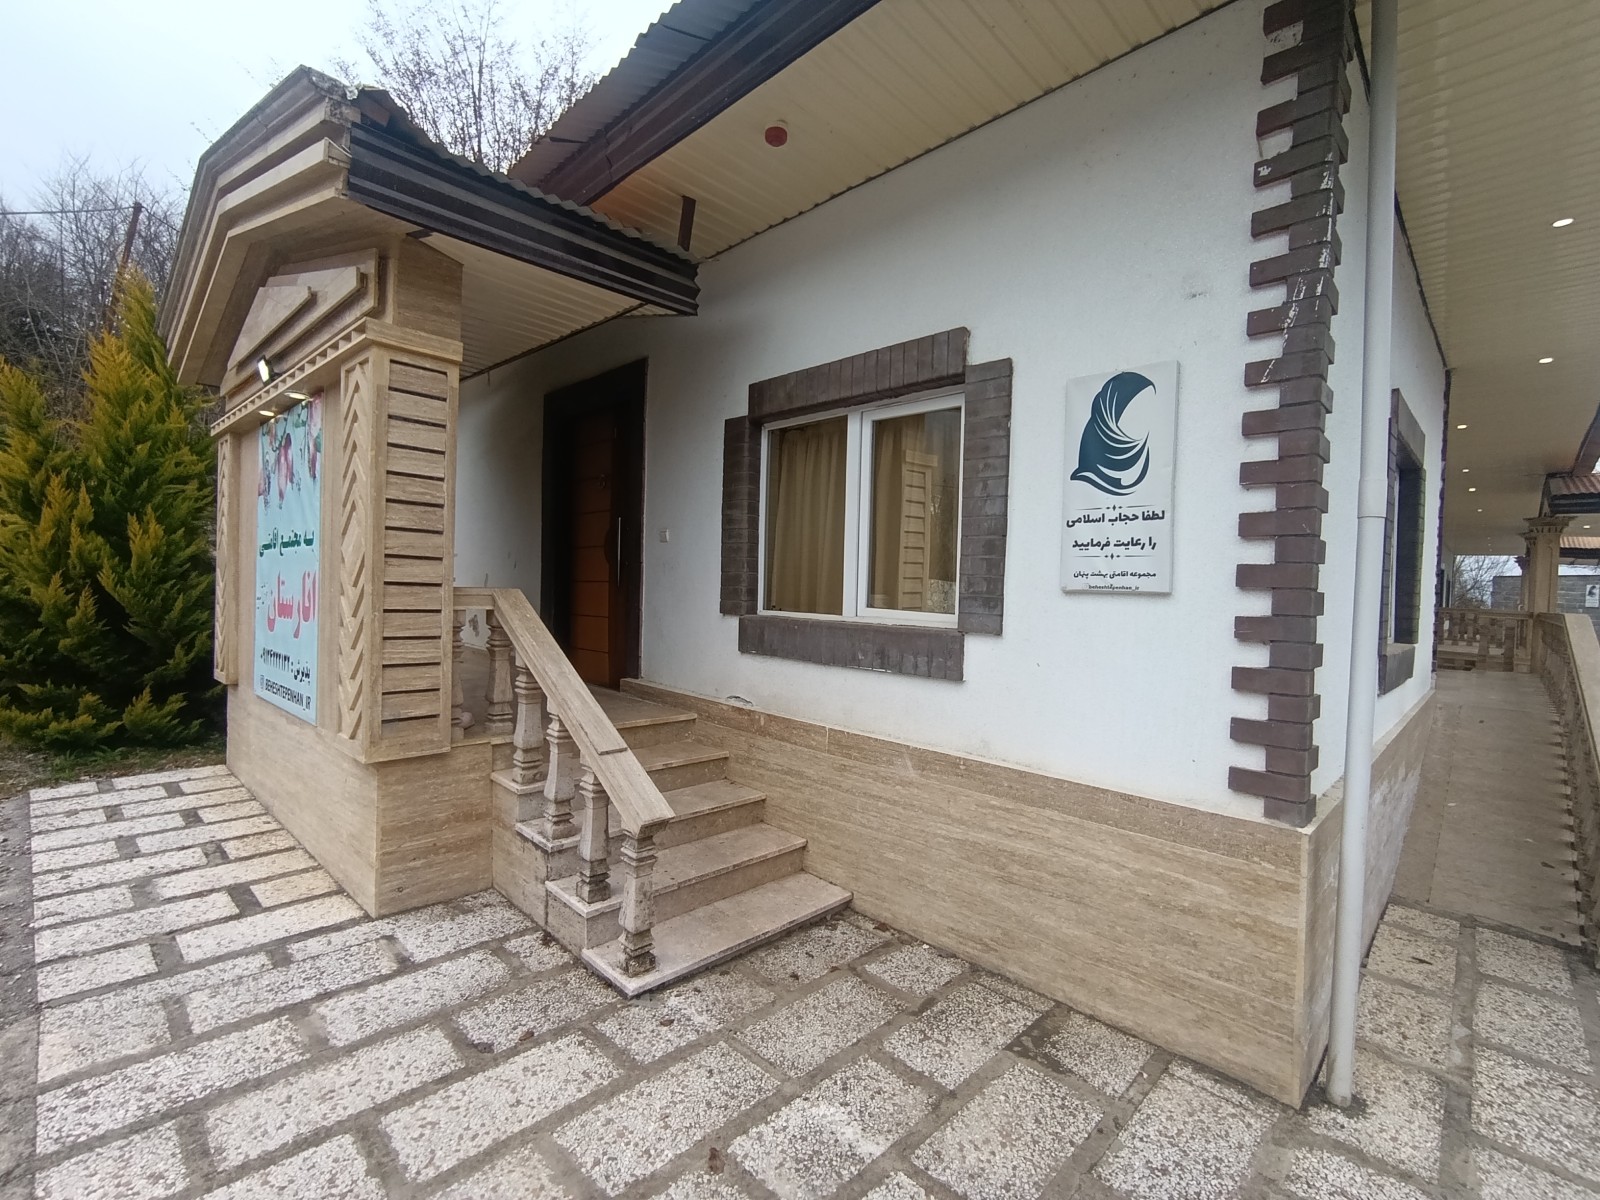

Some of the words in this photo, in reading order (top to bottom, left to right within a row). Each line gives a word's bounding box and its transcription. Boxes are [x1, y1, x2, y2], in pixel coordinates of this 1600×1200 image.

[1066, 513, 1105, 528] اسلامی
[1107, 511, 1139, 526] حجاب
[1141, 509, 1165, 521] لطفا
[1072, 536, 1111, 551] فرمایید
[1113, 536, 1146, 550] رعایت
[1148, 536, 1157, 550] را
[1073, 570, 1089, 579] پنهان
[1089, 569, 1108, 579] بهشت
[1109, 570, 1129, 579] اقامتی
[1129, 570, 1157, 579] مجموعه
[266, 569, 317, 639] انارستان
